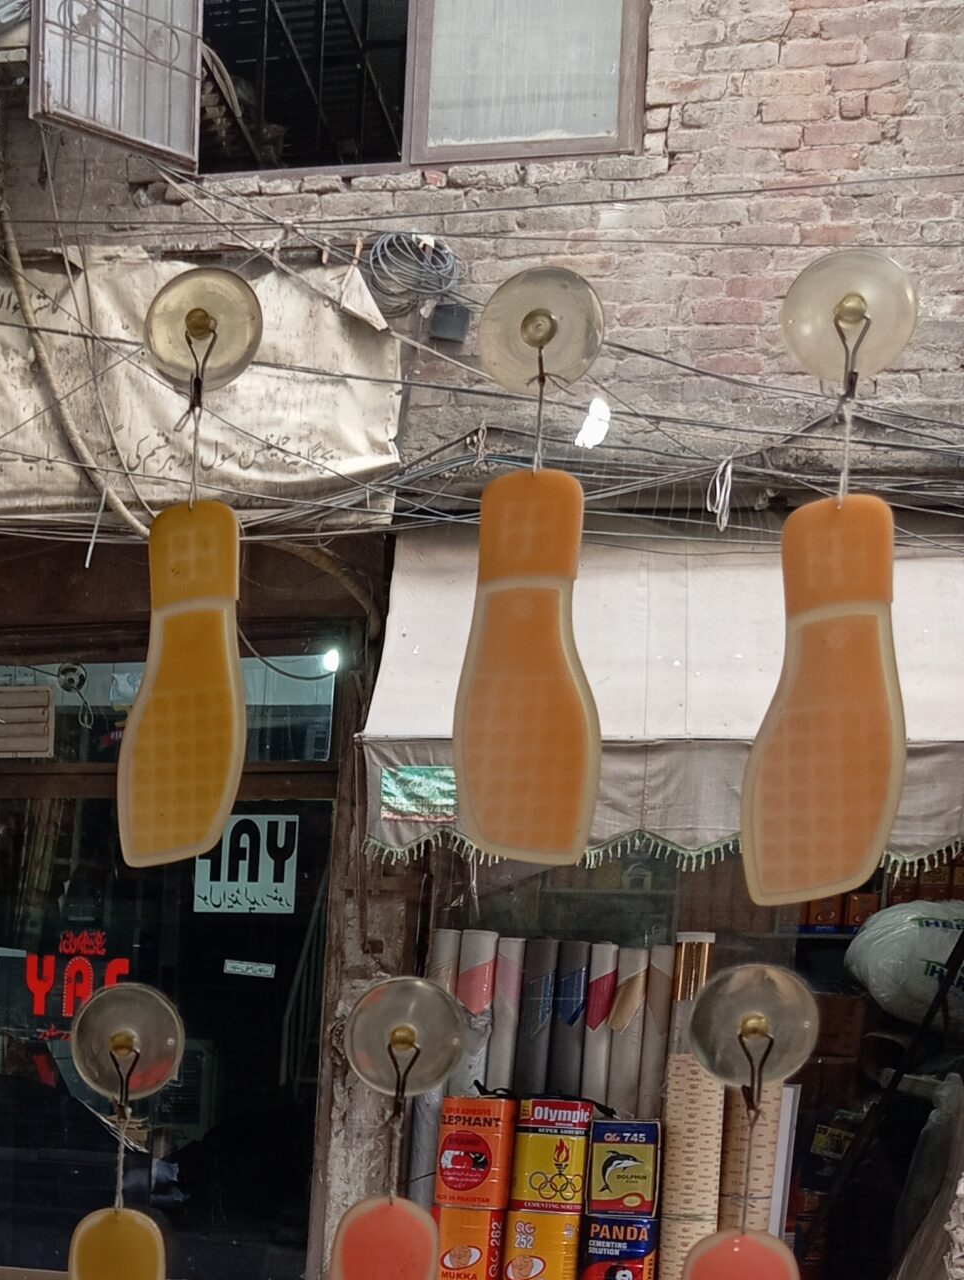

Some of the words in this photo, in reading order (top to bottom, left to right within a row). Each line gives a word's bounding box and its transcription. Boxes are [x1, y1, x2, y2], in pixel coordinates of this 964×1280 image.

[534, 1106, 590, 1123] Olympic
[622, 1132, 647, 1143] 745
[590, 1223, 649, 1242] PANDA
[514, 1233, 535, 1250] 252
[588, 1239, 628, 1250] CEMENTING
[588, 1246, 620, 1256] SOLUTION
[441, 1270, 478, 1280] MUKKA
